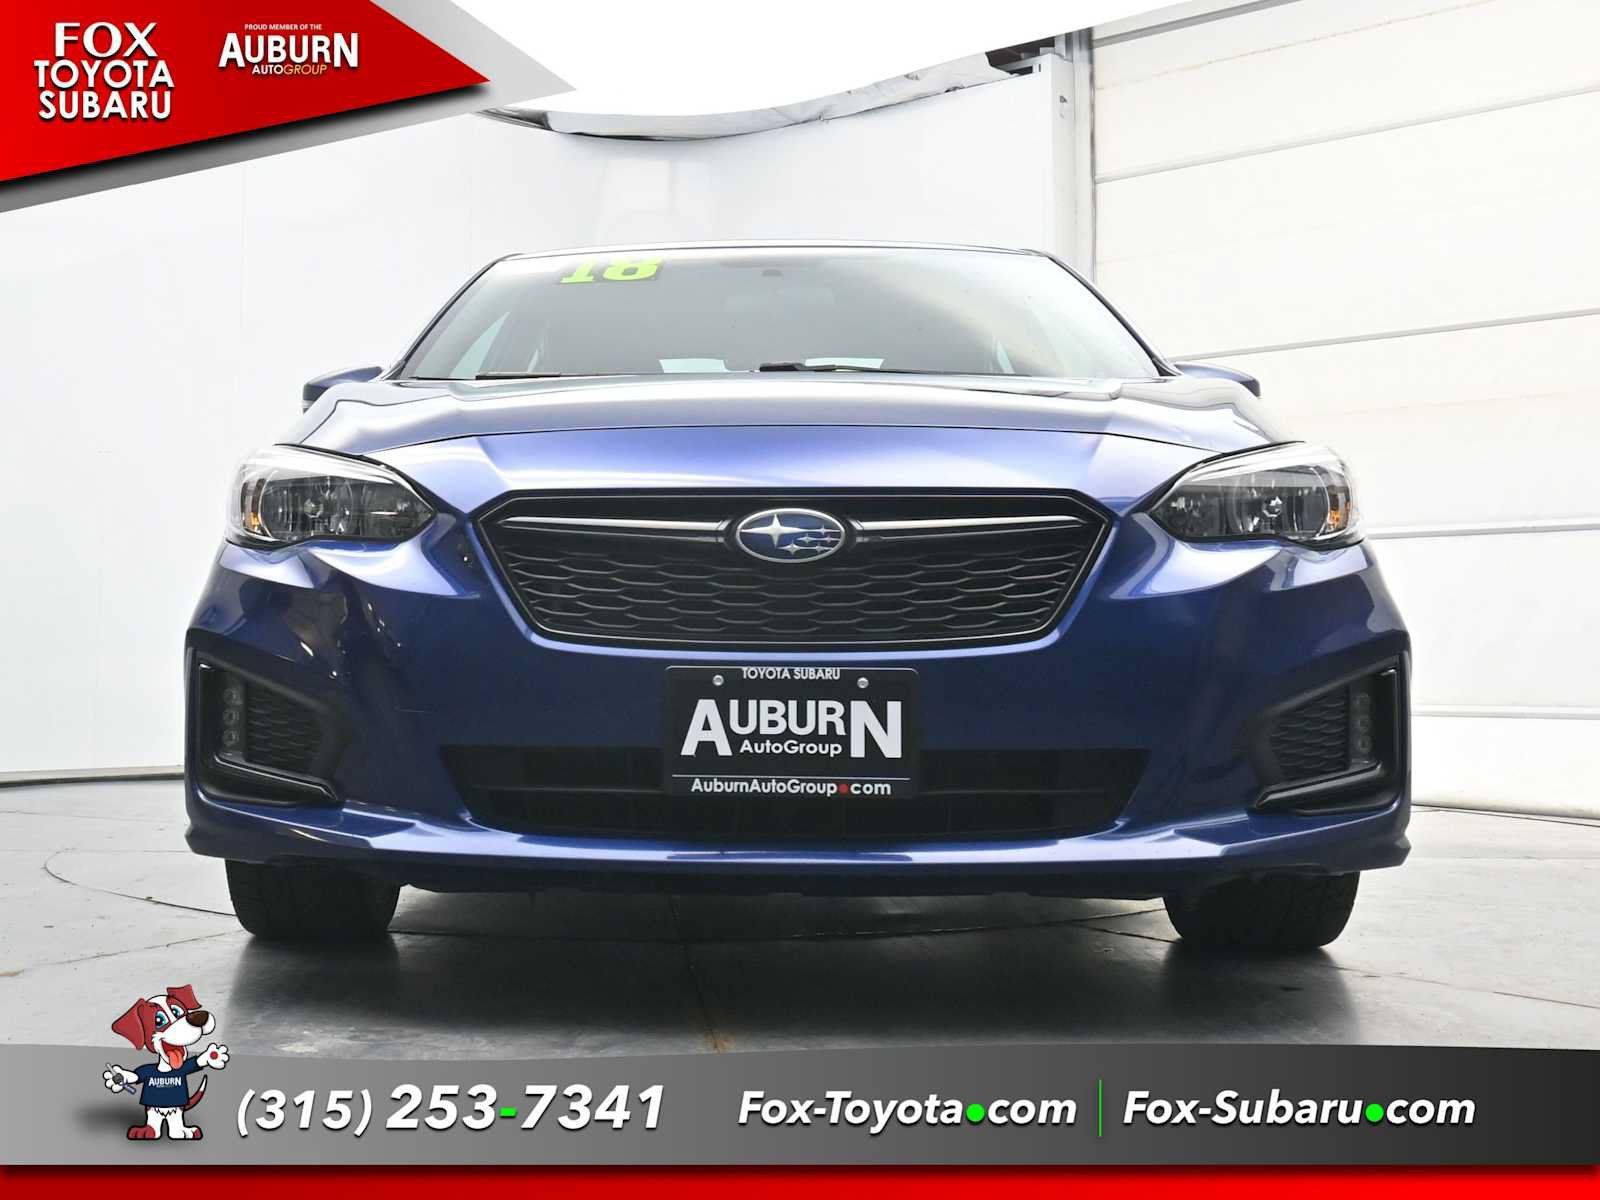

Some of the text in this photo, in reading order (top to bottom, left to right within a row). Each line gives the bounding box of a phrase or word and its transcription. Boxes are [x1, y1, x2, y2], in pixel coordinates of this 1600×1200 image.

[742, 668, 841, 680] TOYOTA SUBARU
[680, 699, 902, 758] AUBURN
[739, 740, 842, 757] AutoGroup
